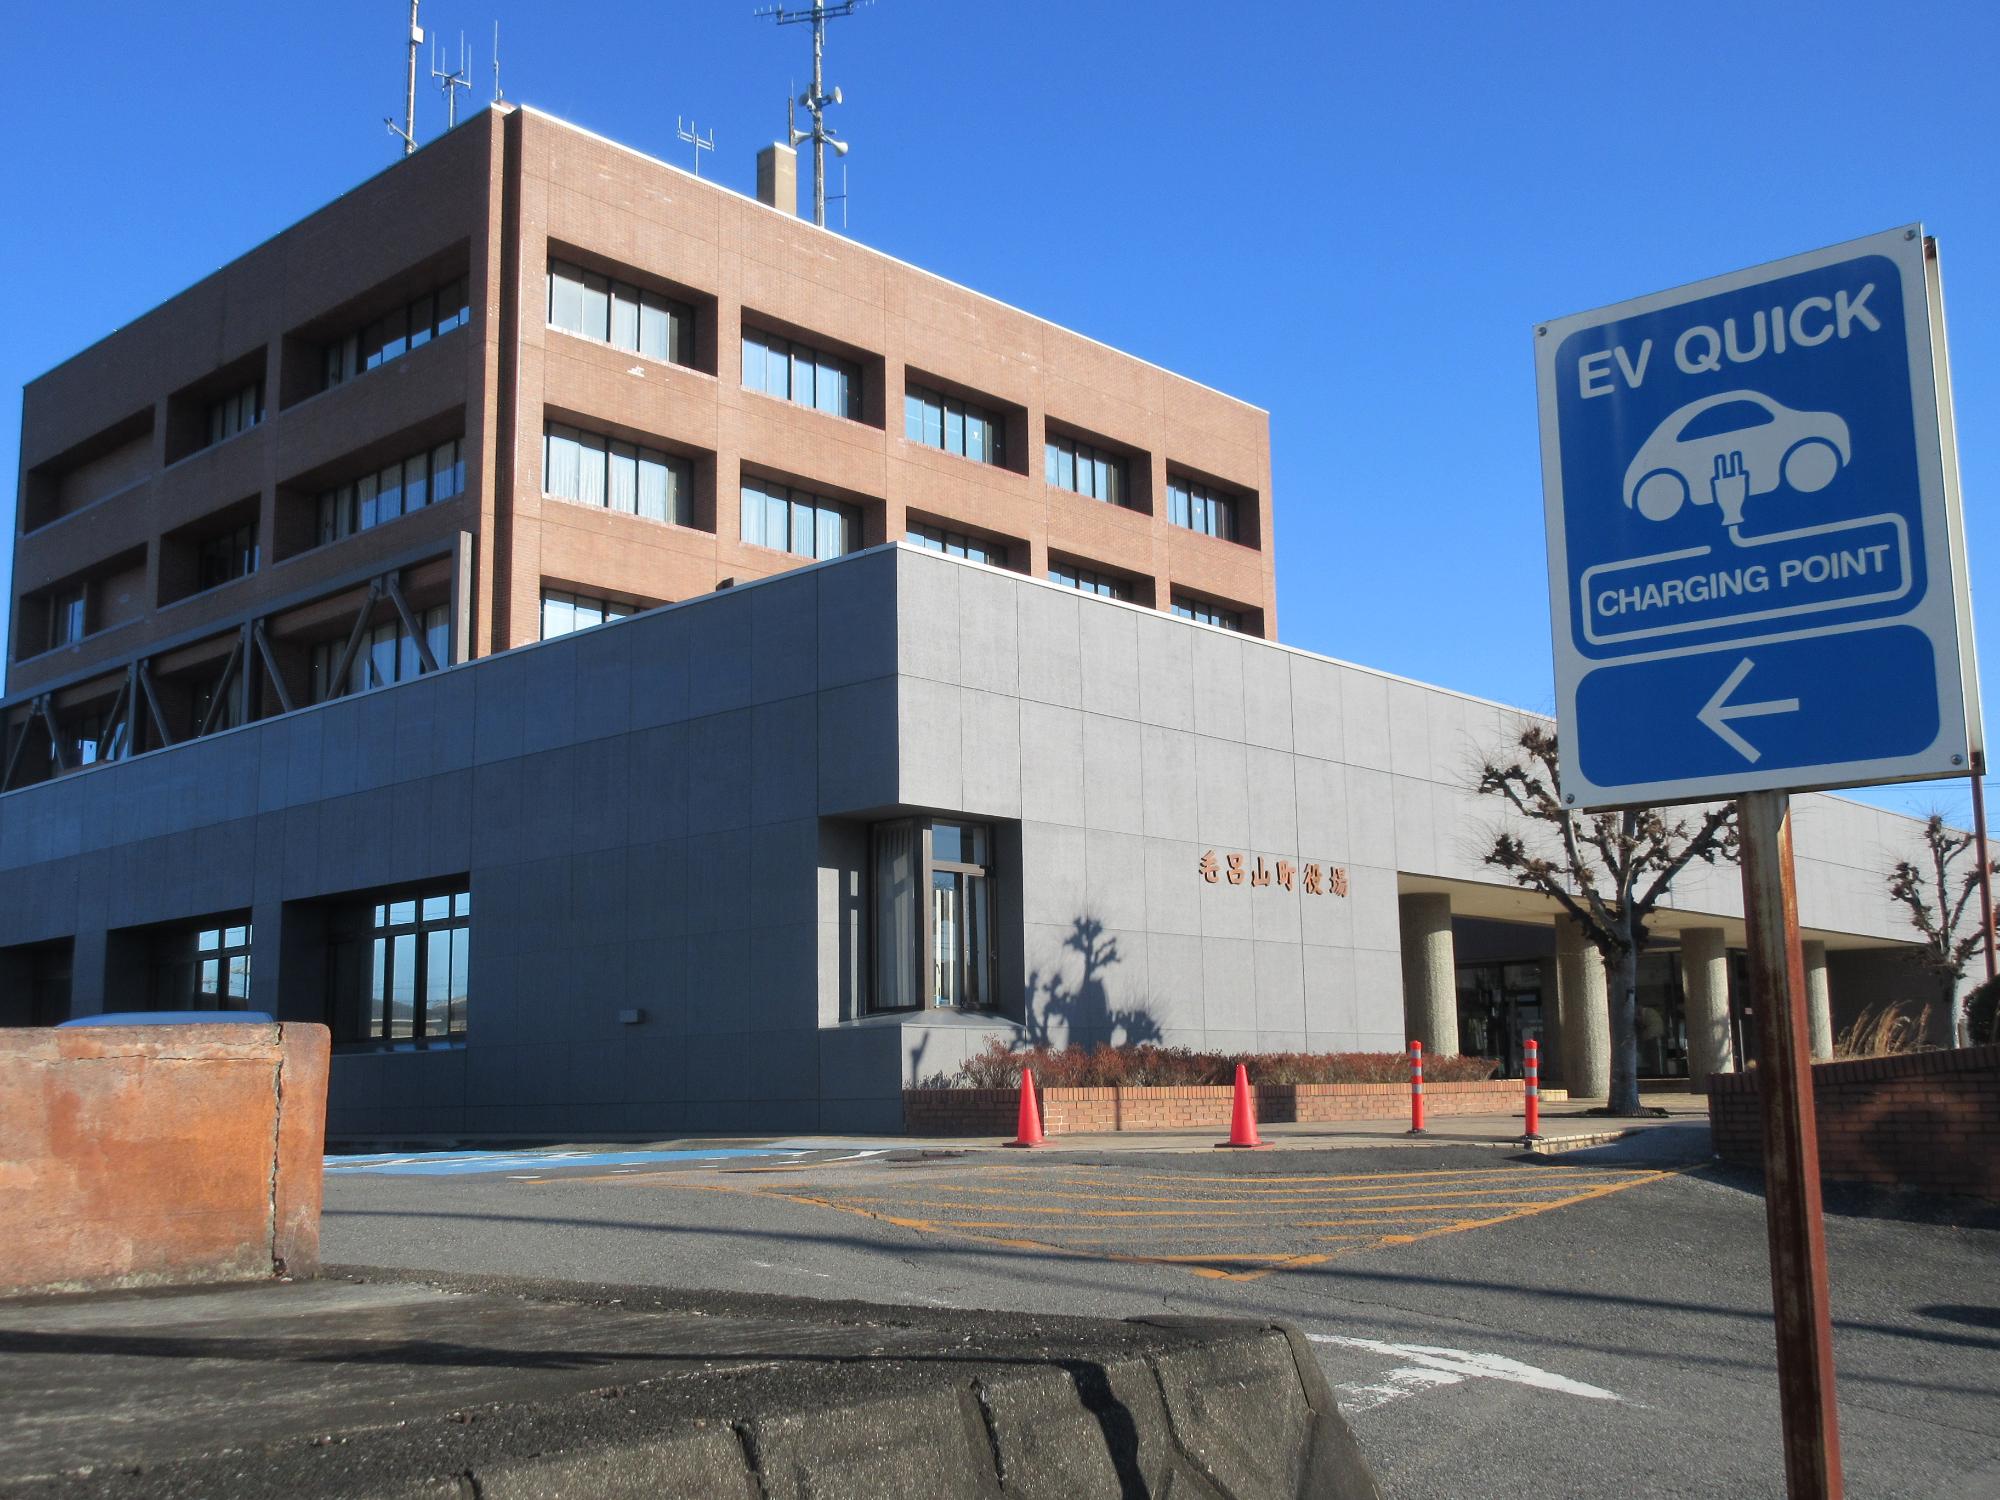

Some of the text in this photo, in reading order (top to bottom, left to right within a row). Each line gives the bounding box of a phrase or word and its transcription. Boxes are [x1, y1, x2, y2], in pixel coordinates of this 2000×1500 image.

[1578, 282, 1882, 400] EV QUICK
[1597, 543, 1891, 617] CHARGING POINT
[1199, 849, 1348, 898] 毛呂山町役場
